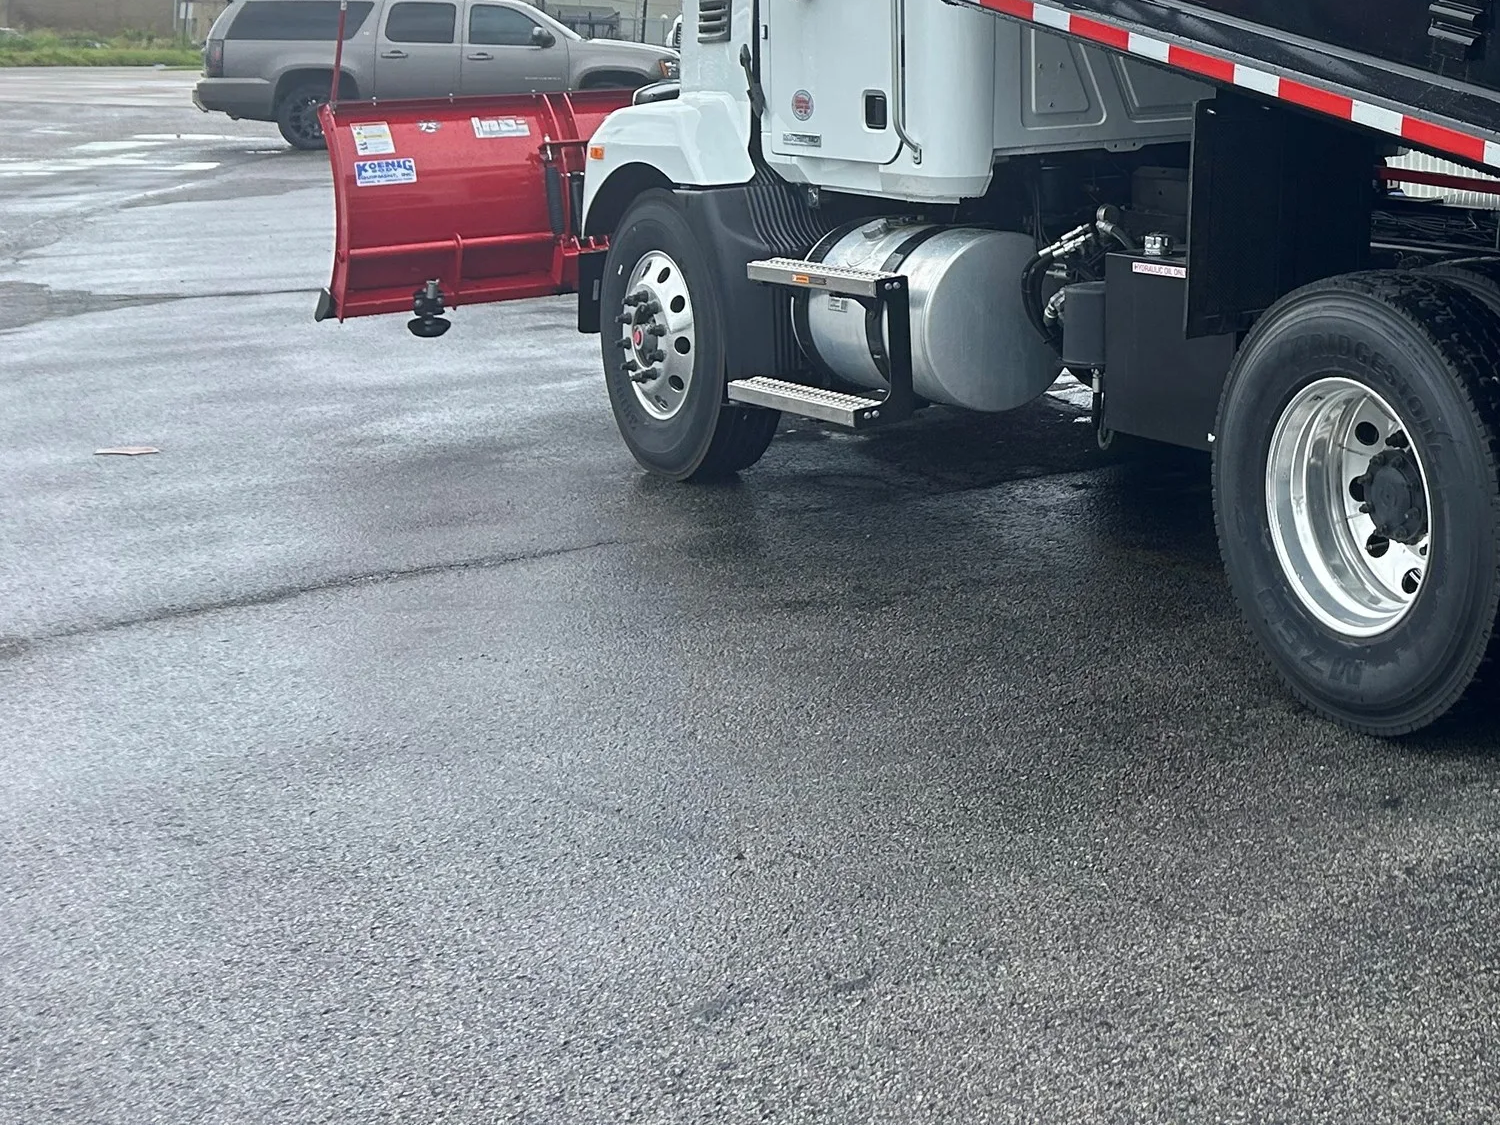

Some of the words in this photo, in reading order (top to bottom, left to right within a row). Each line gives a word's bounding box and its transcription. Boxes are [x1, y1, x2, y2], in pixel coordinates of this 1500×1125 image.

[356, 159, 414, 180] KOENIG
[1134, 263, 1163, 275] HYDRAULIC
[1164, 267, 1173, 275] OIL
